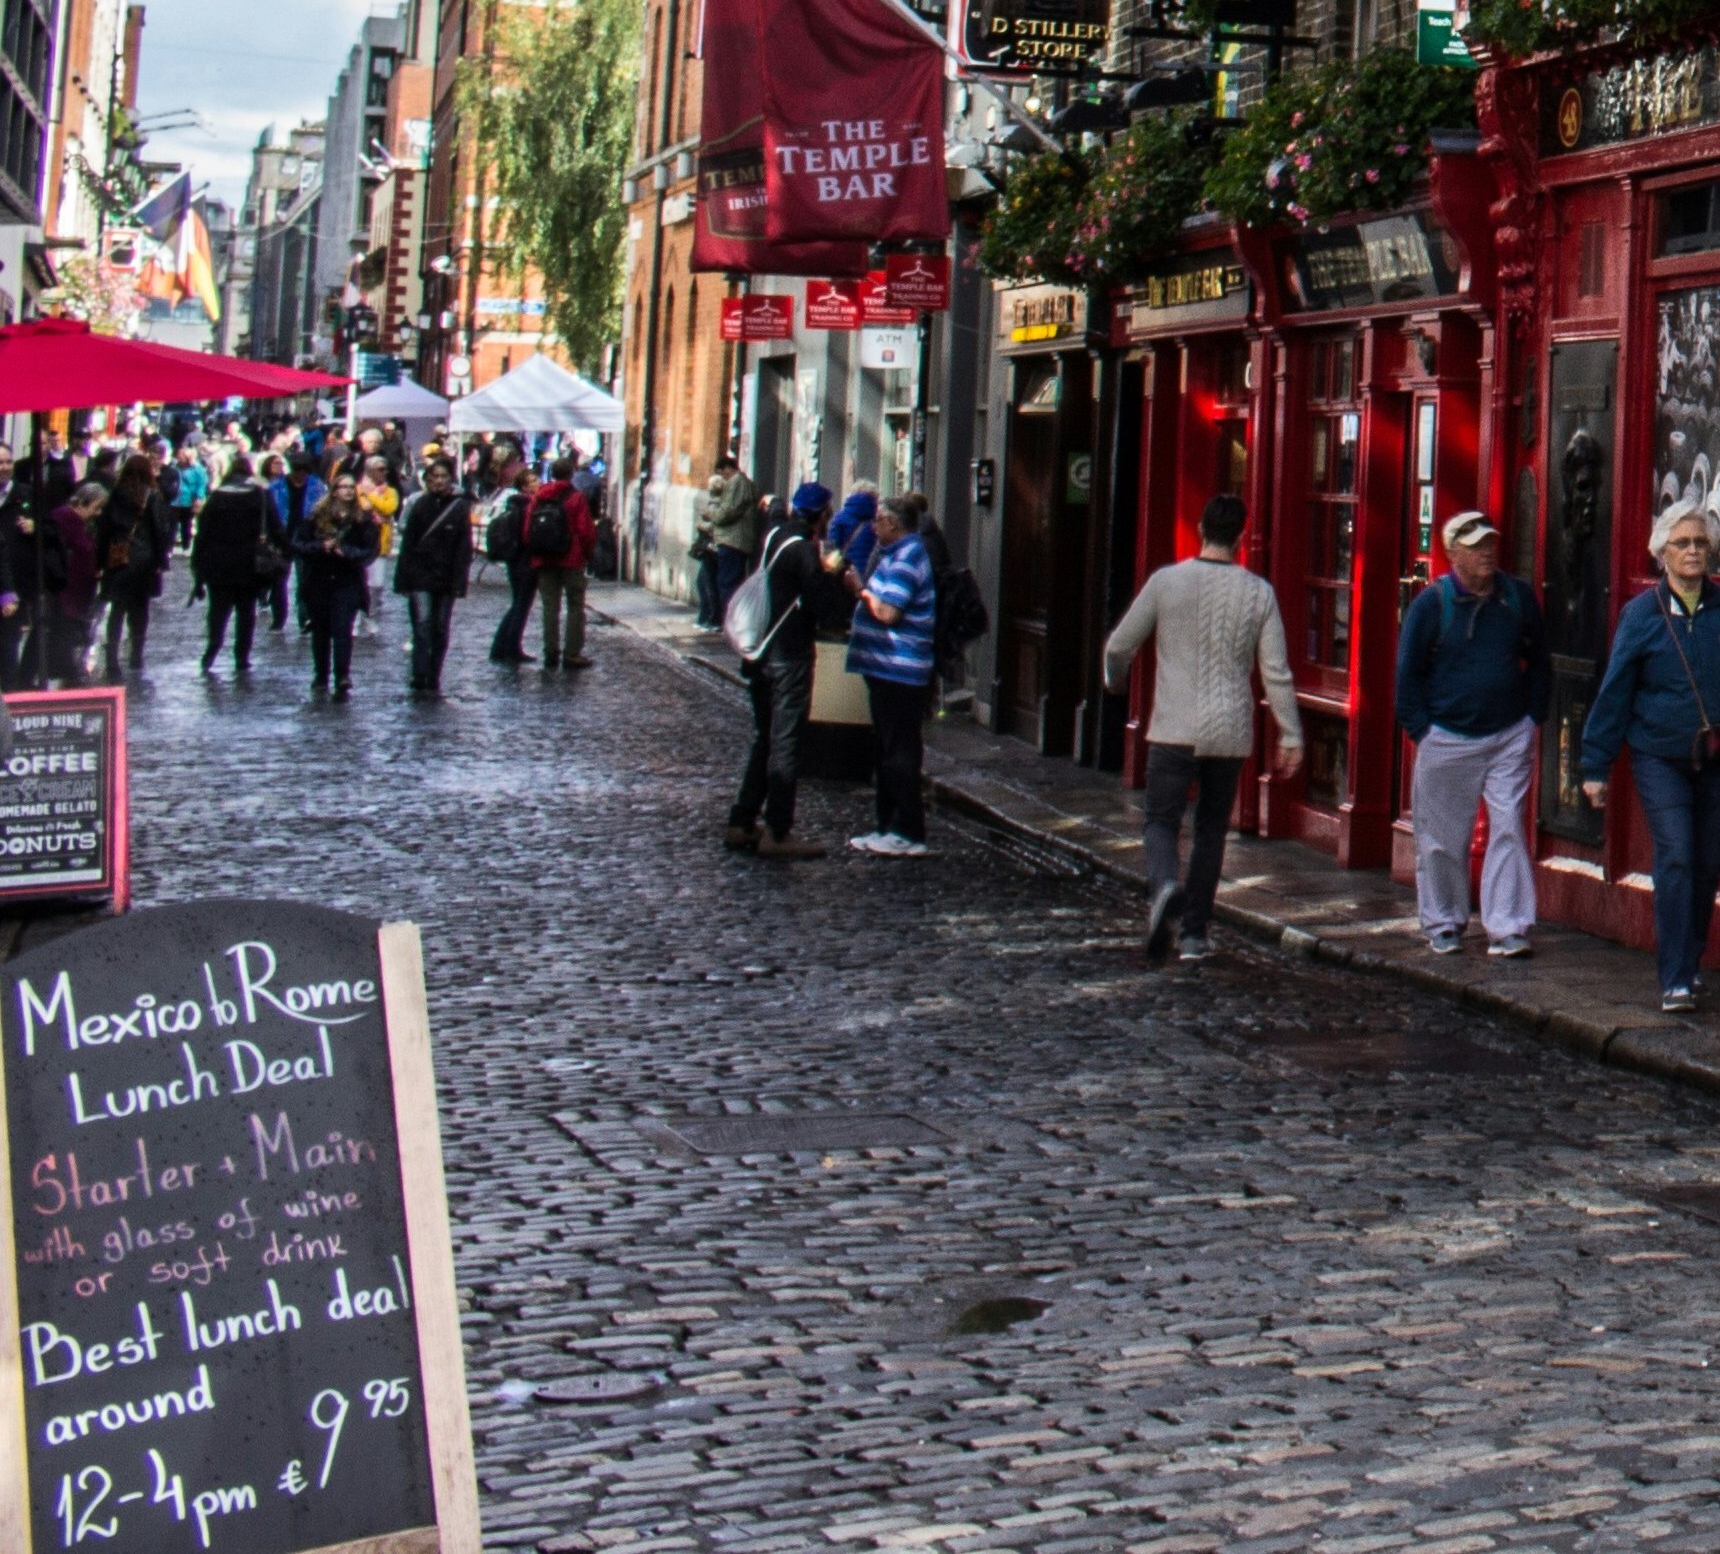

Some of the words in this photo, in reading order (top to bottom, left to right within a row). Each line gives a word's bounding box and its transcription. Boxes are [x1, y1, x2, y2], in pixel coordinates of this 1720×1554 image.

[1017, 40, 1088, 58] STORE
[776, 136, 930, 174] TEMPLE
[822, 120, 886, 142] THE
[706, 166, 763, 189] TEM
[818, 173, 898, 202] BAR
[876, 334, 902, 344] ATM
[0, 752, 97, 777] OFFEE
[19, 970, 202, 1056] Mexico
[203, 961, 238, 1026] to
[225, 941, 378, 1026] Rome
[69, 1041, 219, 1125] Lunch
[226, 1024, 334, 1095] Deal
[31, 1137, 201, 1217] Starter
[249, 1109, 378, 1181] Main
[24, 1226, 86, 1266] with
[104, 1216, 196, 1263] glass
[219, 1197, 260, 1239] of
[284, 1189, 362, 1221] wine
[75, 1270, 113, 1298] or
[148, 1242, 232, 1286] soft
[261, 1231, 348, 1267] drink
[20, 1301, 164, 1386] Best
[181, 1277, 302, 1352] lunch
[328, 1254, 411, 1322] deal
[44, 1363, 215, 1447] around
